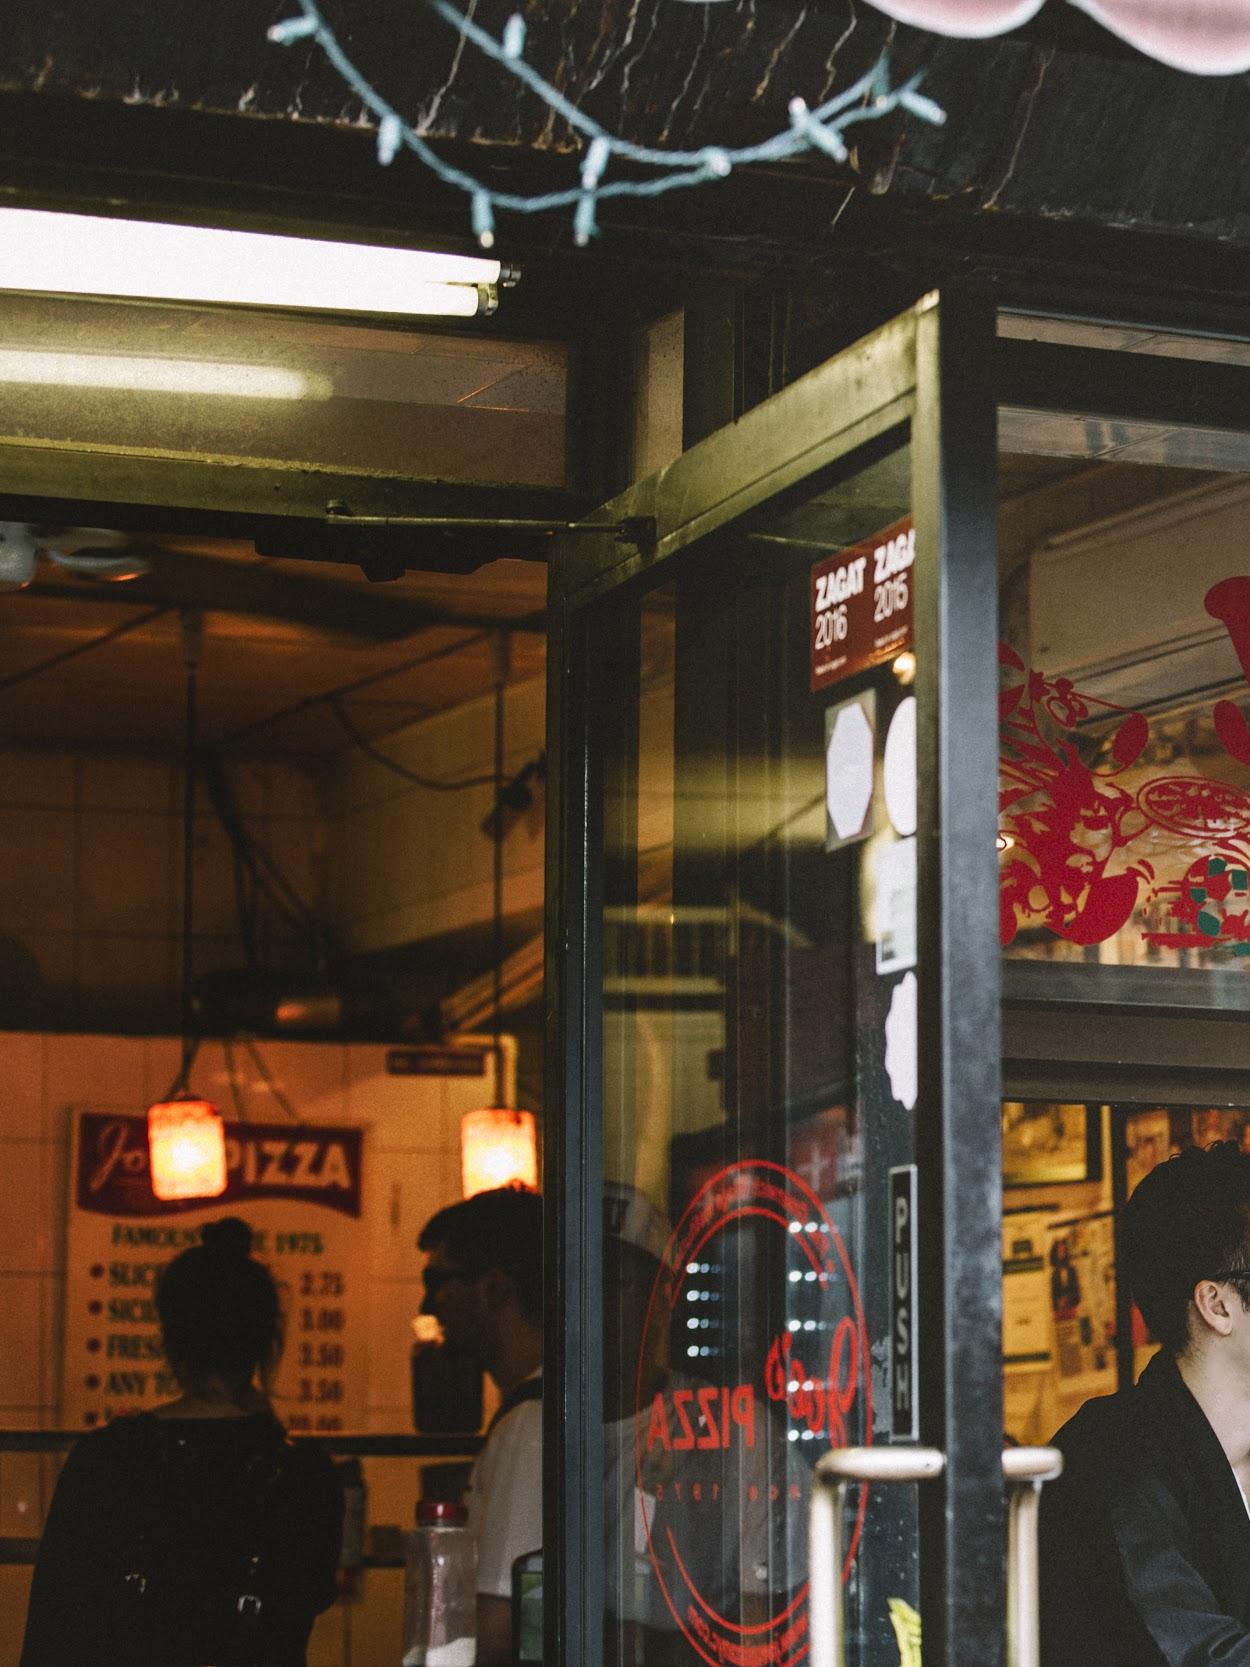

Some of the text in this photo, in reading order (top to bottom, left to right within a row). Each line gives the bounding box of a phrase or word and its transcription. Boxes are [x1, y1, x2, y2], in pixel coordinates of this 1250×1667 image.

[815, 556, 867, 613] ZAGAT
[873, 572, 909, 623] 2015
[814, 604, 848, 650] 2016
[895, 1196, 909, 1410] PUSH
